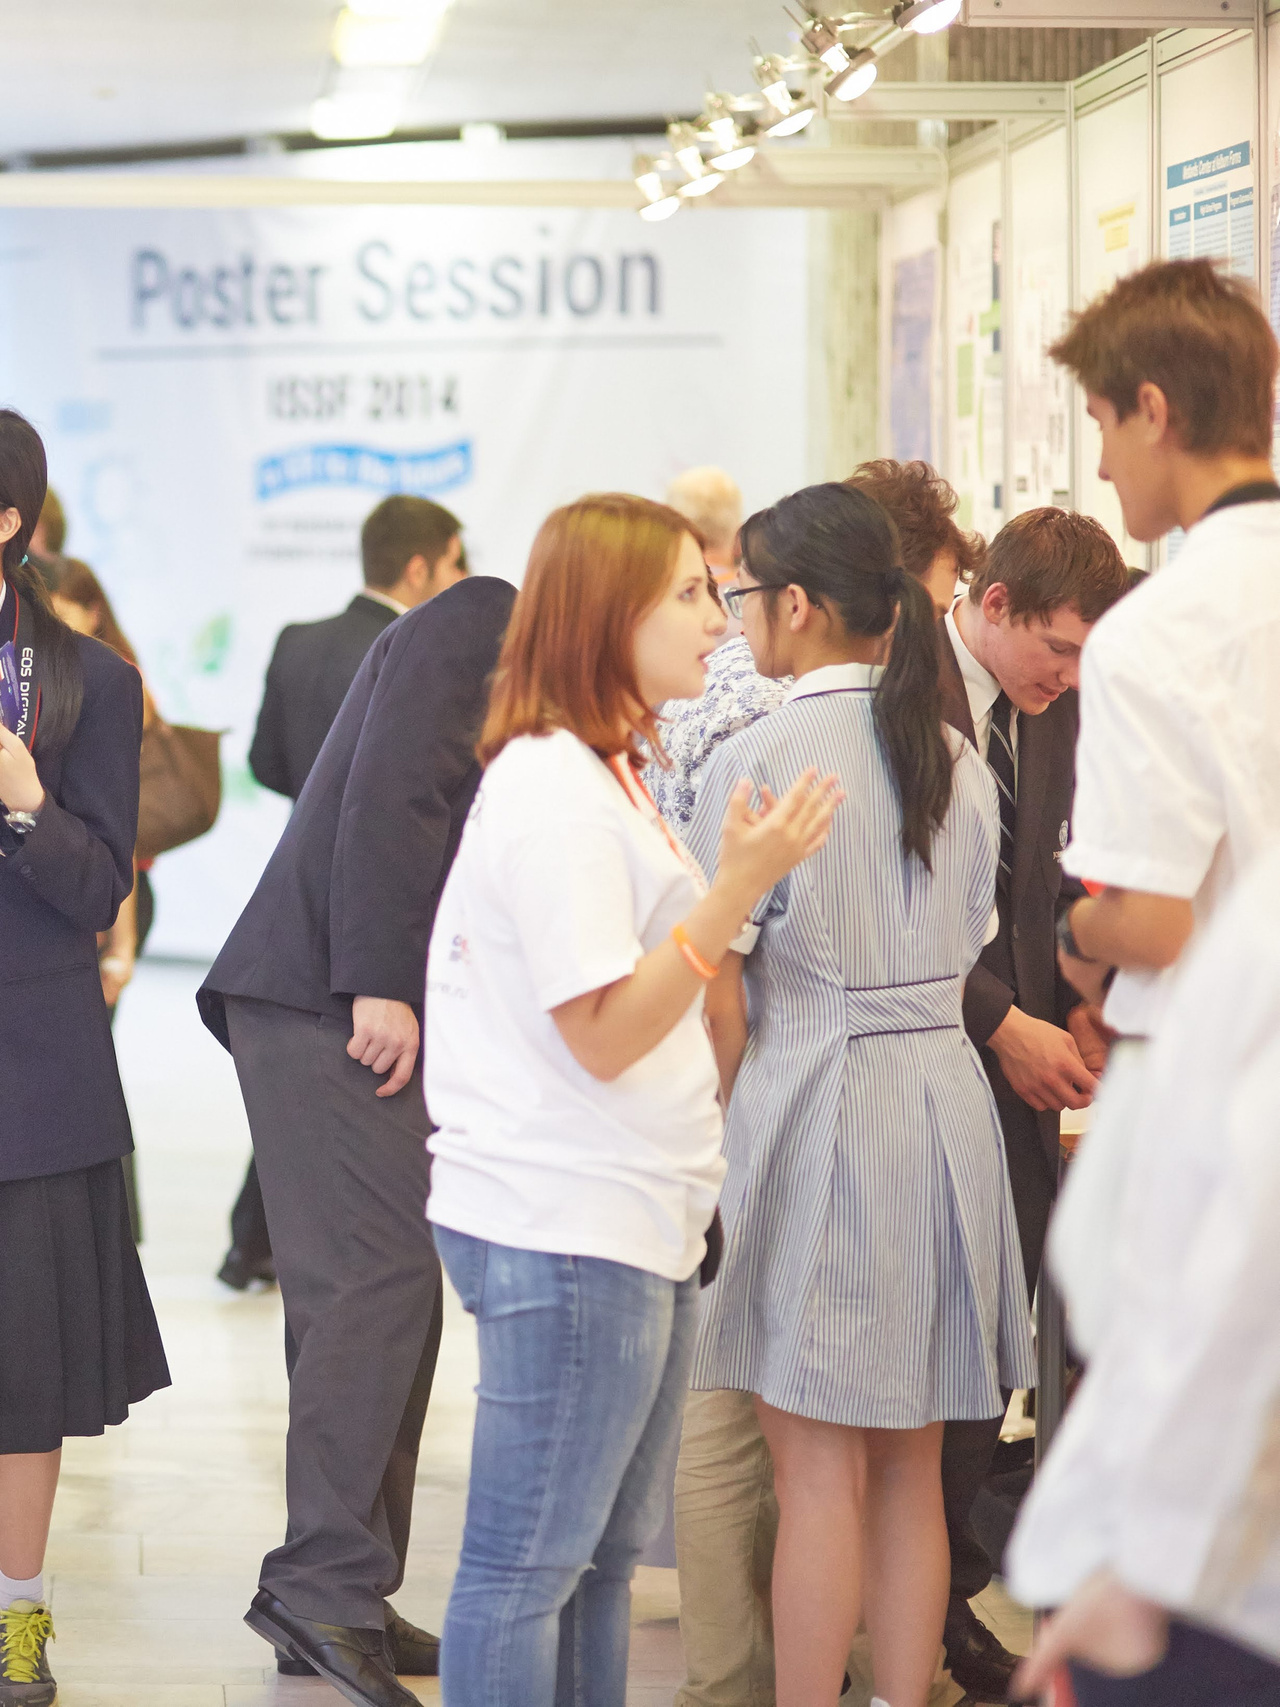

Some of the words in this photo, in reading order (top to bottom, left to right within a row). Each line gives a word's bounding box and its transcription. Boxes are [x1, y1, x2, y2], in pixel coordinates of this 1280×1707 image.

[130, 247, 327, 329] Poster
[356, 227, 659, 322] Session
[267, 373, 349, 421] ISSF
[369, 374, 460, 421] 2014
[20, 647, 34, 677] EOS
